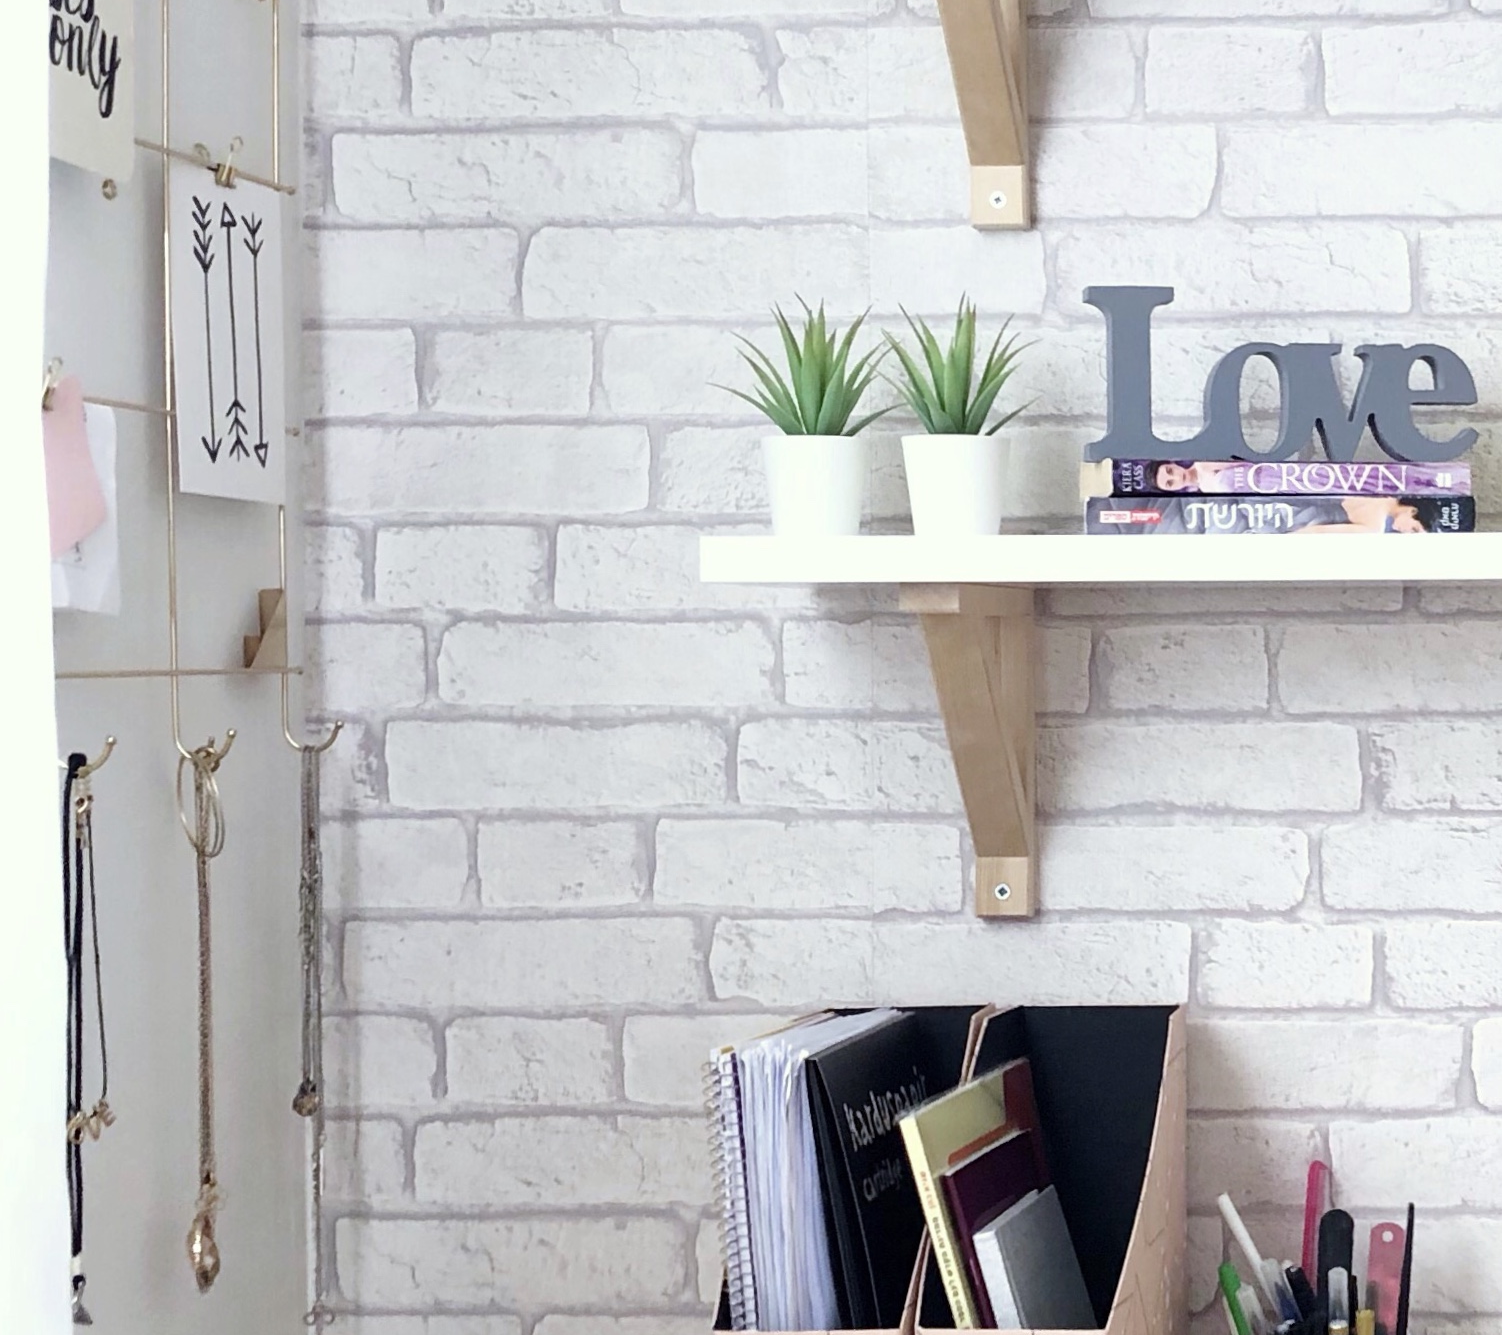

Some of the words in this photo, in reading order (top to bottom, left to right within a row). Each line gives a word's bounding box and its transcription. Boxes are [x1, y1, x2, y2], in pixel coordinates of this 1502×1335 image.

[49, 14, 122, 118] only
[1082, 286, 1480, 462] Love
[1122, 462, 1132, 493] KIERA
[1133, 465, 1144, 491] CASS
[1234, 466, 1245, 488] THE
[1247, 462, 1408, 494] CROWN
[1185, 502, 1294, 530] היורשת
